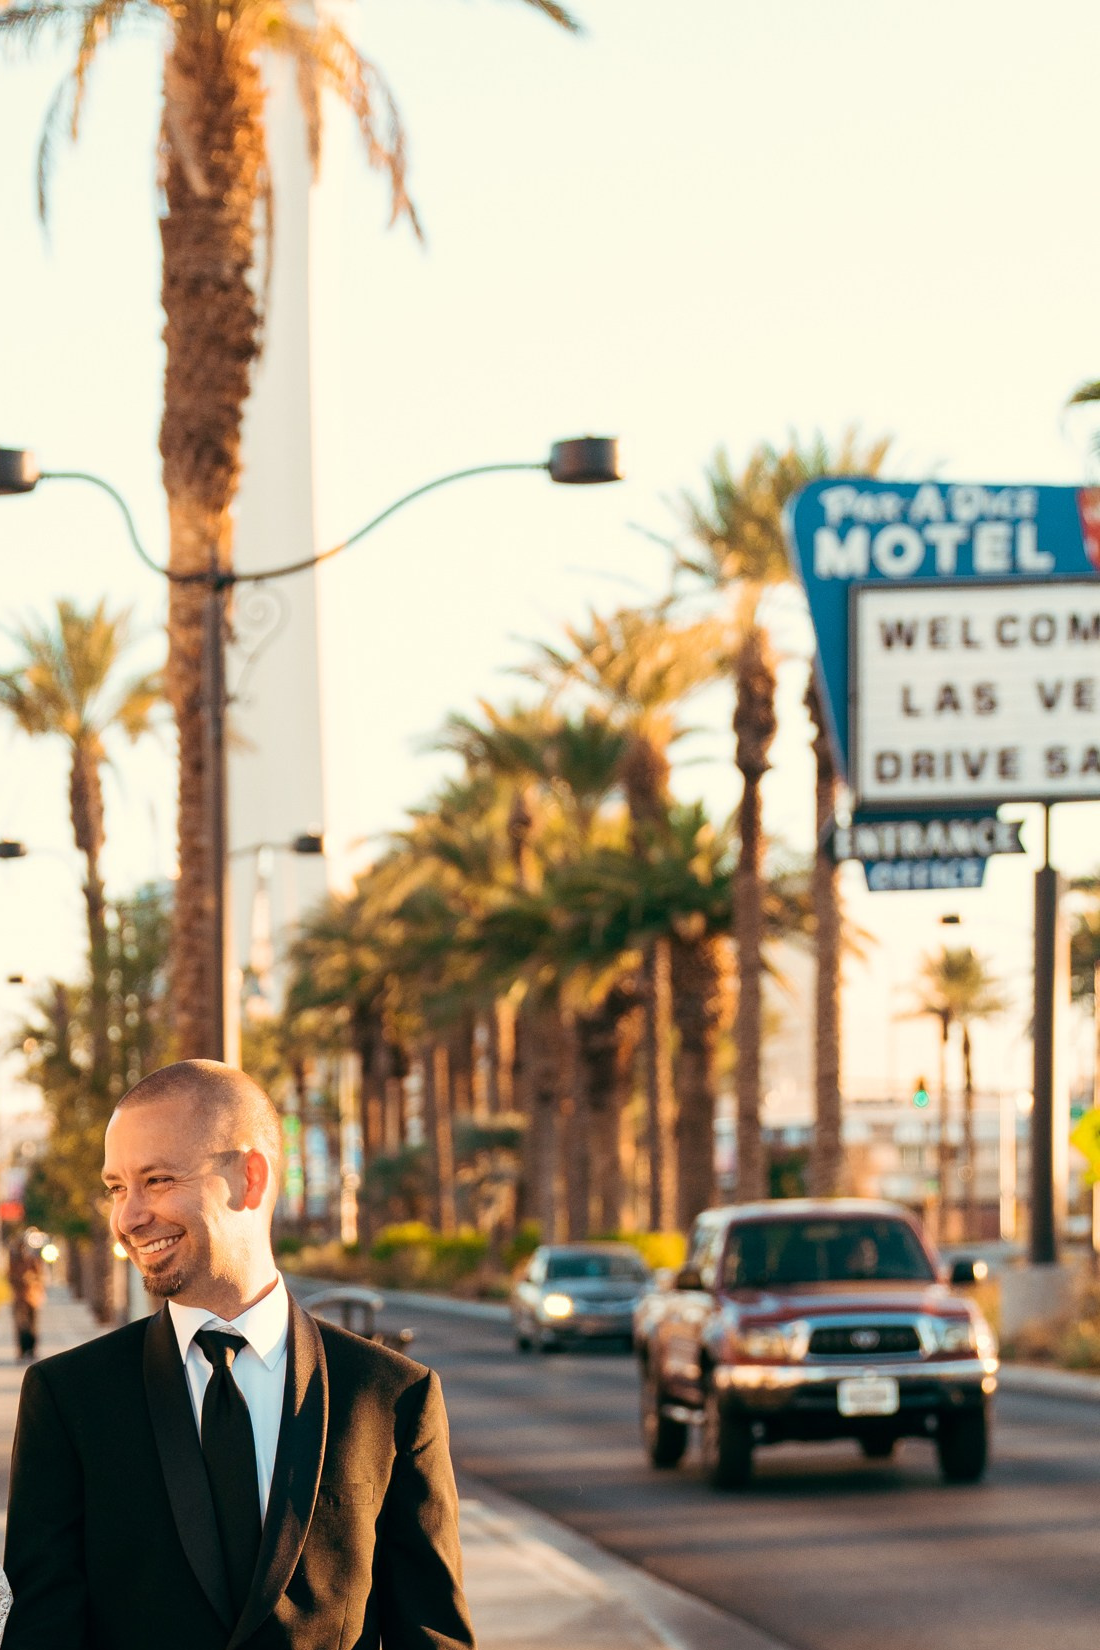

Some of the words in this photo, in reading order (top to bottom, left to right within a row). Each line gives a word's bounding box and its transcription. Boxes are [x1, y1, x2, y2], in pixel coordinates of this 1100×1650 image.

[812, 519, 1056, 580] MOTEL
[877, 611, 1100, 651] WELCOM
[900, 680, 997, 720] LAS
[1036, 675, 1097, 714] VE
[874, 746, 1020, 786] DRIVE
[1044, 745, 1100, 781] SA
